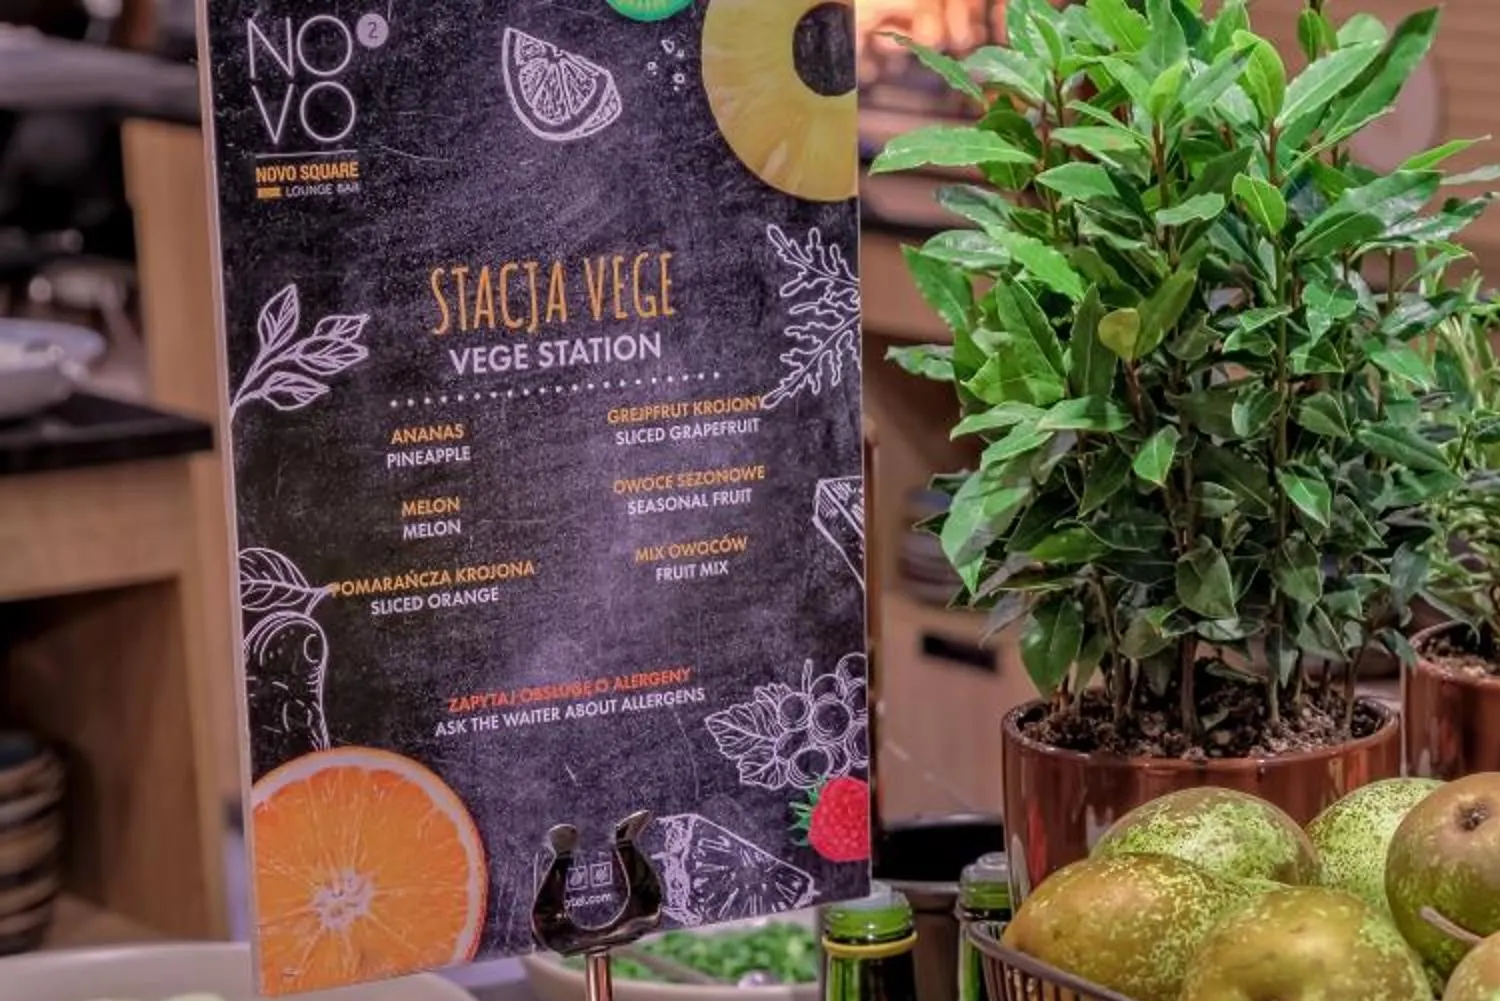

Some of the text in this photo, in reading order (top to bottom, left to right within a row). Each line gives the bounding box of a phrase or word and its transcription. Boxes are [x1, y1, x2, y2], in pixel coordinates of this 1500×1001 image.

[247, 15, 353, 79] NO
[251, 80, 356, 145] VO
[256, 161, 360, 183] NOVO SQUARE
[285, 183, 334, 198] LOUNGE
[429, 251, 676, 336] STACJA VEGE
[450, 332, 662, 375] VEGE STATION
[607, 404, 689, 424] GREJPFRUT
[390, 423, 465, 445] ANANAS
[615, 417, 761, 446] SLICED GRAPEFRUIT
[386, 445, 471, 469] PINEAPPLE
[613, 465, 766, 495] OWOCE SEZONOWE
[401, 496, 461, 517] MELON
[627, 487, 753, 516] SEASONAL FRUIT
[403, 519, 462, 541] MELON
[635, 534, 749, 563] MIX OWOCÓW
[330, 560, 536, 598] POMARAŃCZA KROJONA
[655, 559, 729, 582] FRUIT MIX
[371, 586, 500, 616] SLICED ORANGE
[447, 689, 516, 713] ZAPYTAJ
[613, 667, 693, 690] ALERGENY
[434, 687, 706, 737] ASK THE WAITER ABOUT ALLERGENS
